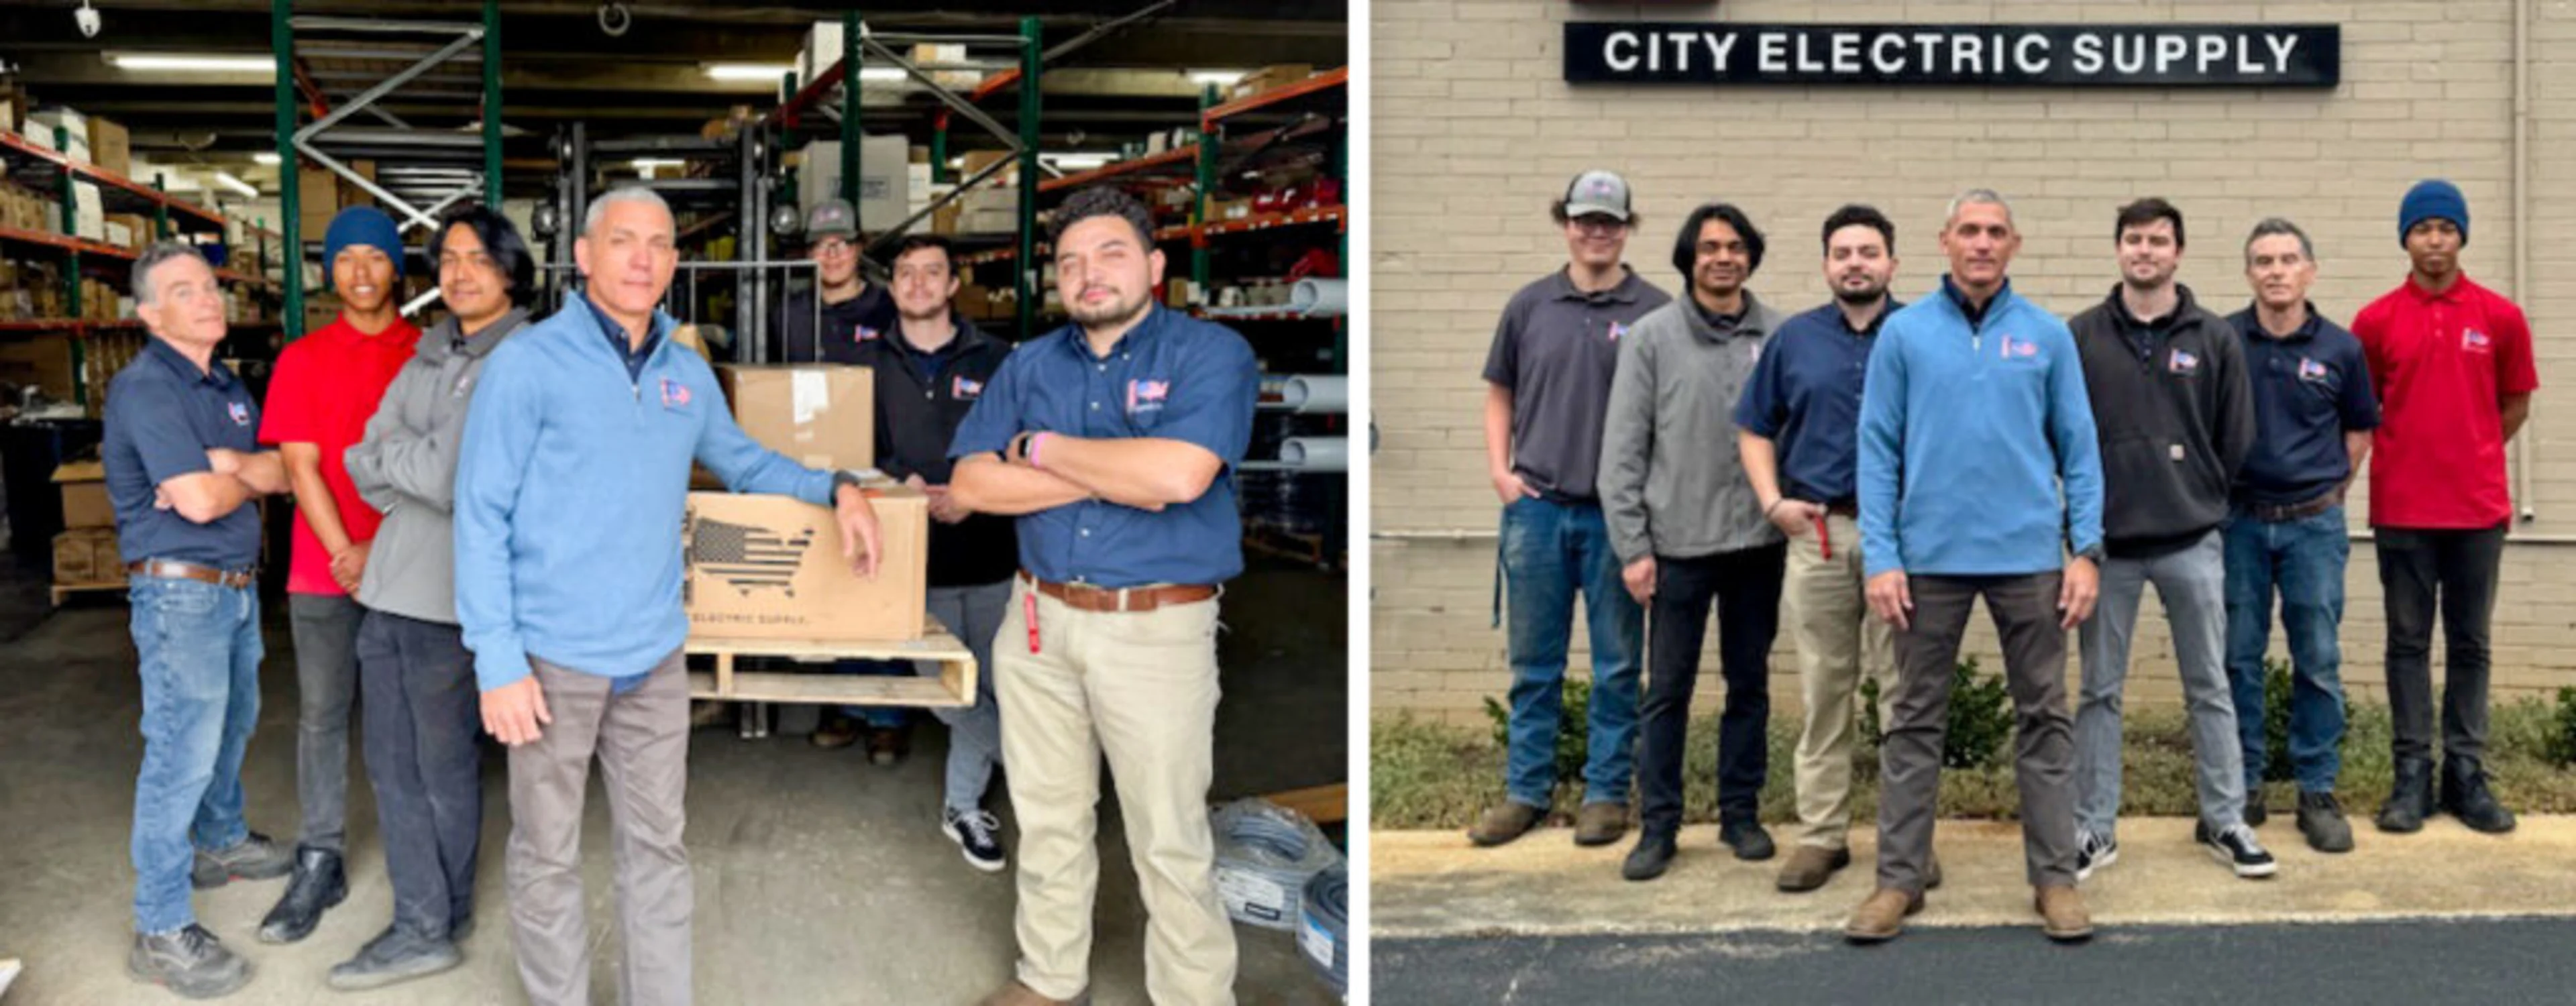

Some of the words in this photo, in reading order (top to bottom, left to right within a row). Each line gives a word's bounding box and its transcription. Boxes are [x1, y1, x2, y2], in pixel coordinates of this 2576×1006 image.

[1603, 32, 1737, 71] CITY
[1758, 32, 2050, 74] ELECTRIC
[2072, 33, 2298, 74] SUPPLY
